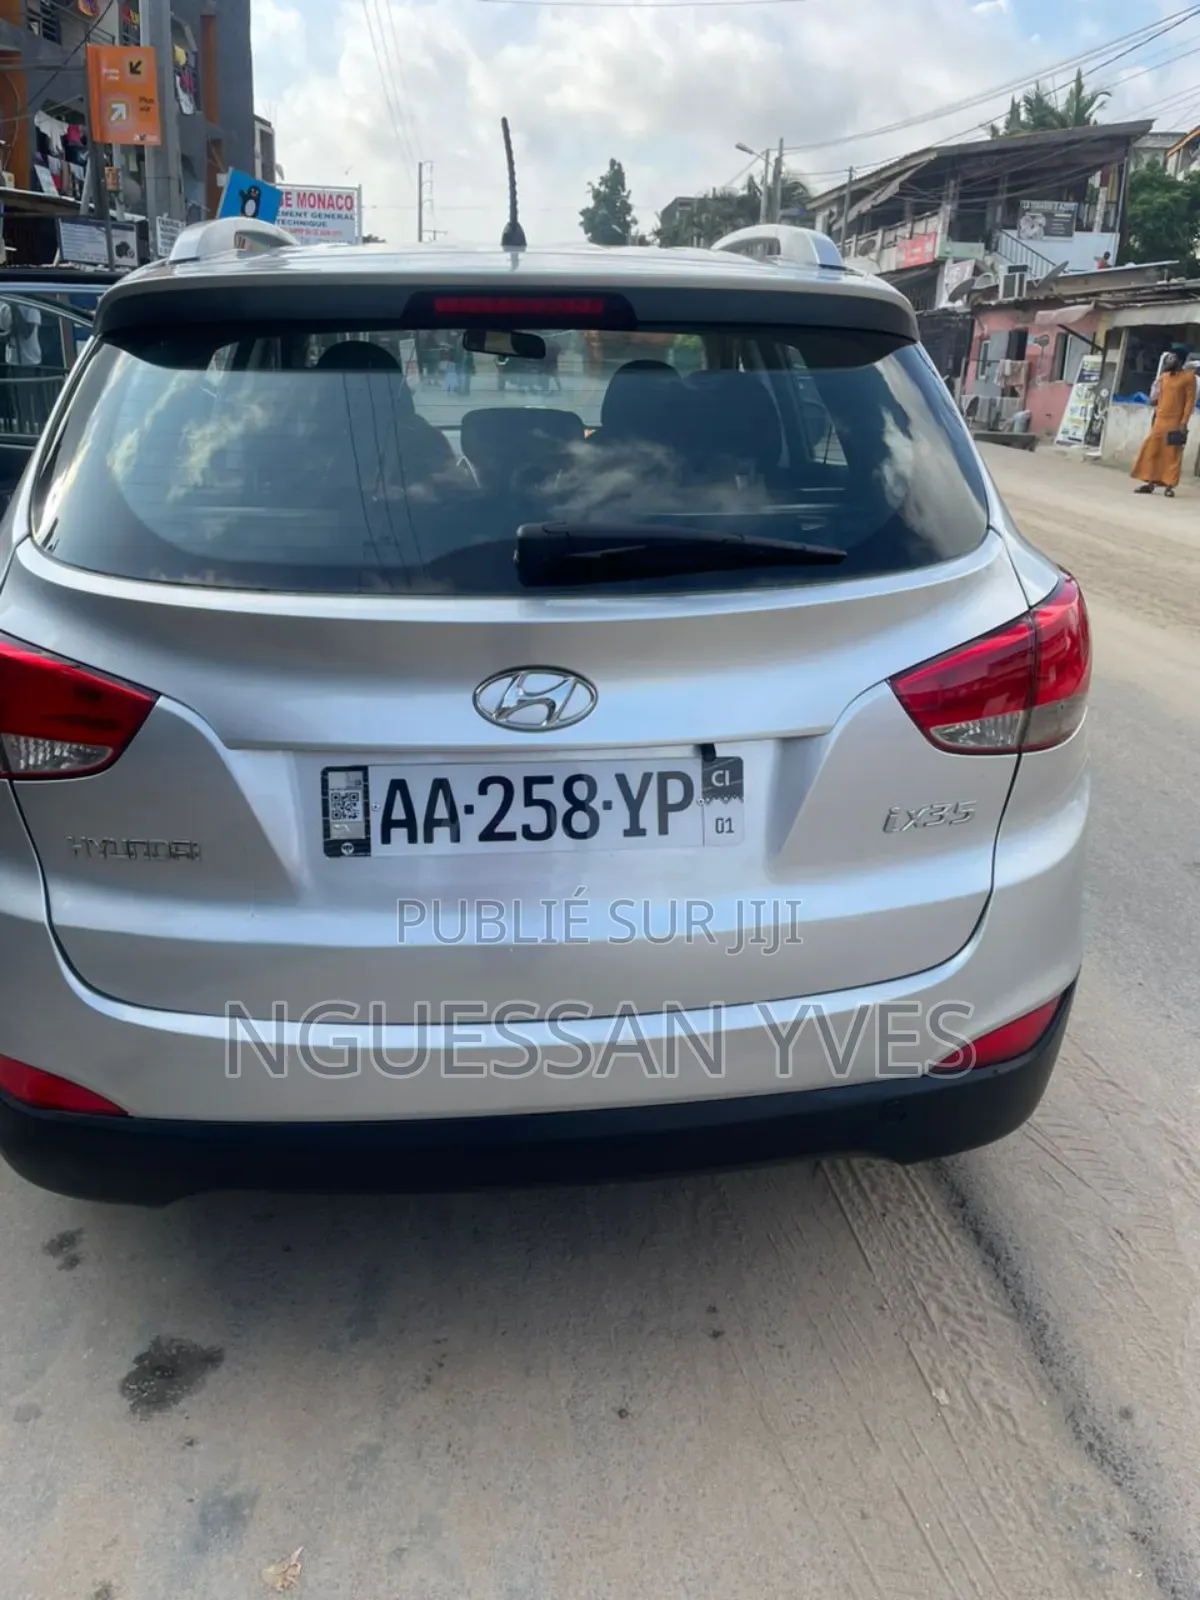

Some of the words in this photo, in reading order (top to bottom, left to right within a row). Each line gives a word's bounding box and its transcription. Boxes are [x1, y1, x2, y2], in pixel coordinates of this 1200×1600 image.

[296, 191, 354, 211] MONACO
[311, 211, 355, 221] GENERAL
[711, 769, 730, 787] CI
[715, 817, 734, 834] 01
